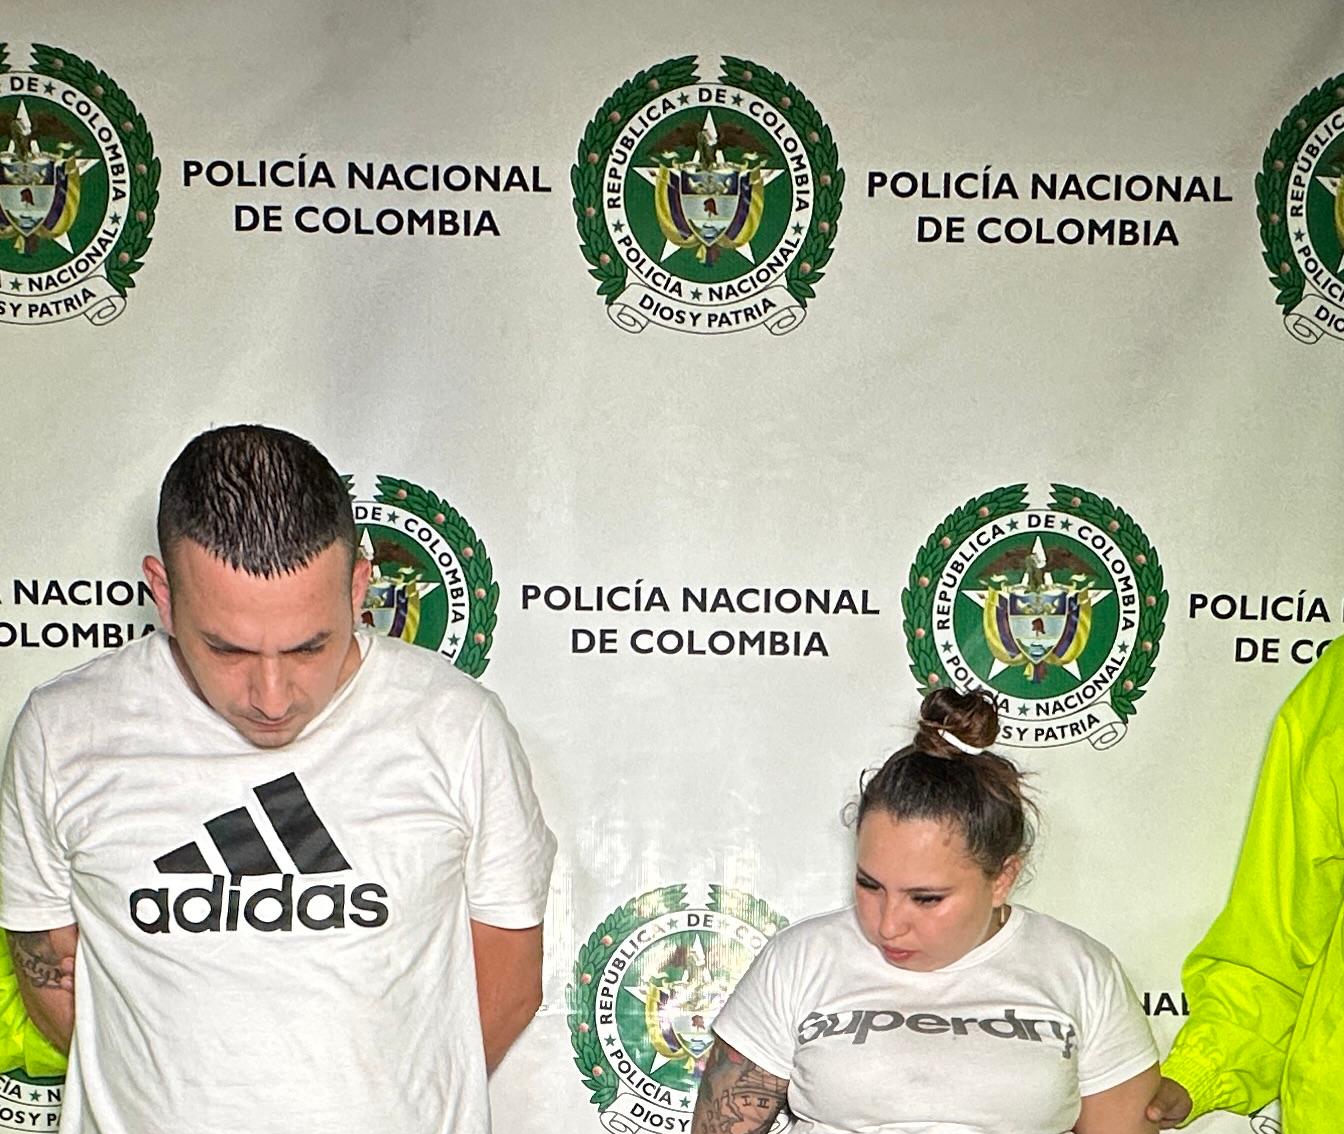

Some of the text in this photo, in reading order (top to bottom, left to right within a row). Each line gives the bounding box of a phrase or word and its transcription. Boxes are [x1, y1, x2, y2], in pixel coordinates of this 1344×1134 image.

[10, 77, 39, 92] DE
[61, 90, 127, 201] COLOMBIA
[697, 88, 727, 103] DE
[748, 101, 811, 211] COLOMBIA
[184, 153, 551, 192] POLICÍA NACIONAL
[868, 165, 1232, 202] POLICÍA NACIONAL
[235, 205, 500, 236] DE COLOMBIA
[918, 217, 1179, 246] DE COLOMBIA
[28, 226, 119, 292] NACIONAL
[708, 237, 801, 301] NACIONAL
[28, 287, 96, 318] PATRIA
[708, 297, 776, 327] PATRIA
[356, 507, 464, 623] DE COLOMBIA
[1027, 513, 1056, 528] DE
[1077, 526, 1136, 631] COLOMBIA
[523, 579, 879, 614] POLICÍA NACIONAL
[1190, 590, 1330, 622] POLICÍA
[572, 629, 828, 656] DE COLOMBIA
[1236, 638, 1279, 663] DE
[1034, 655, 1126, 717] NACIONAL
[1033, 712, 1101, 742] PATRIA
[129, 870, 389, 935] adidas
